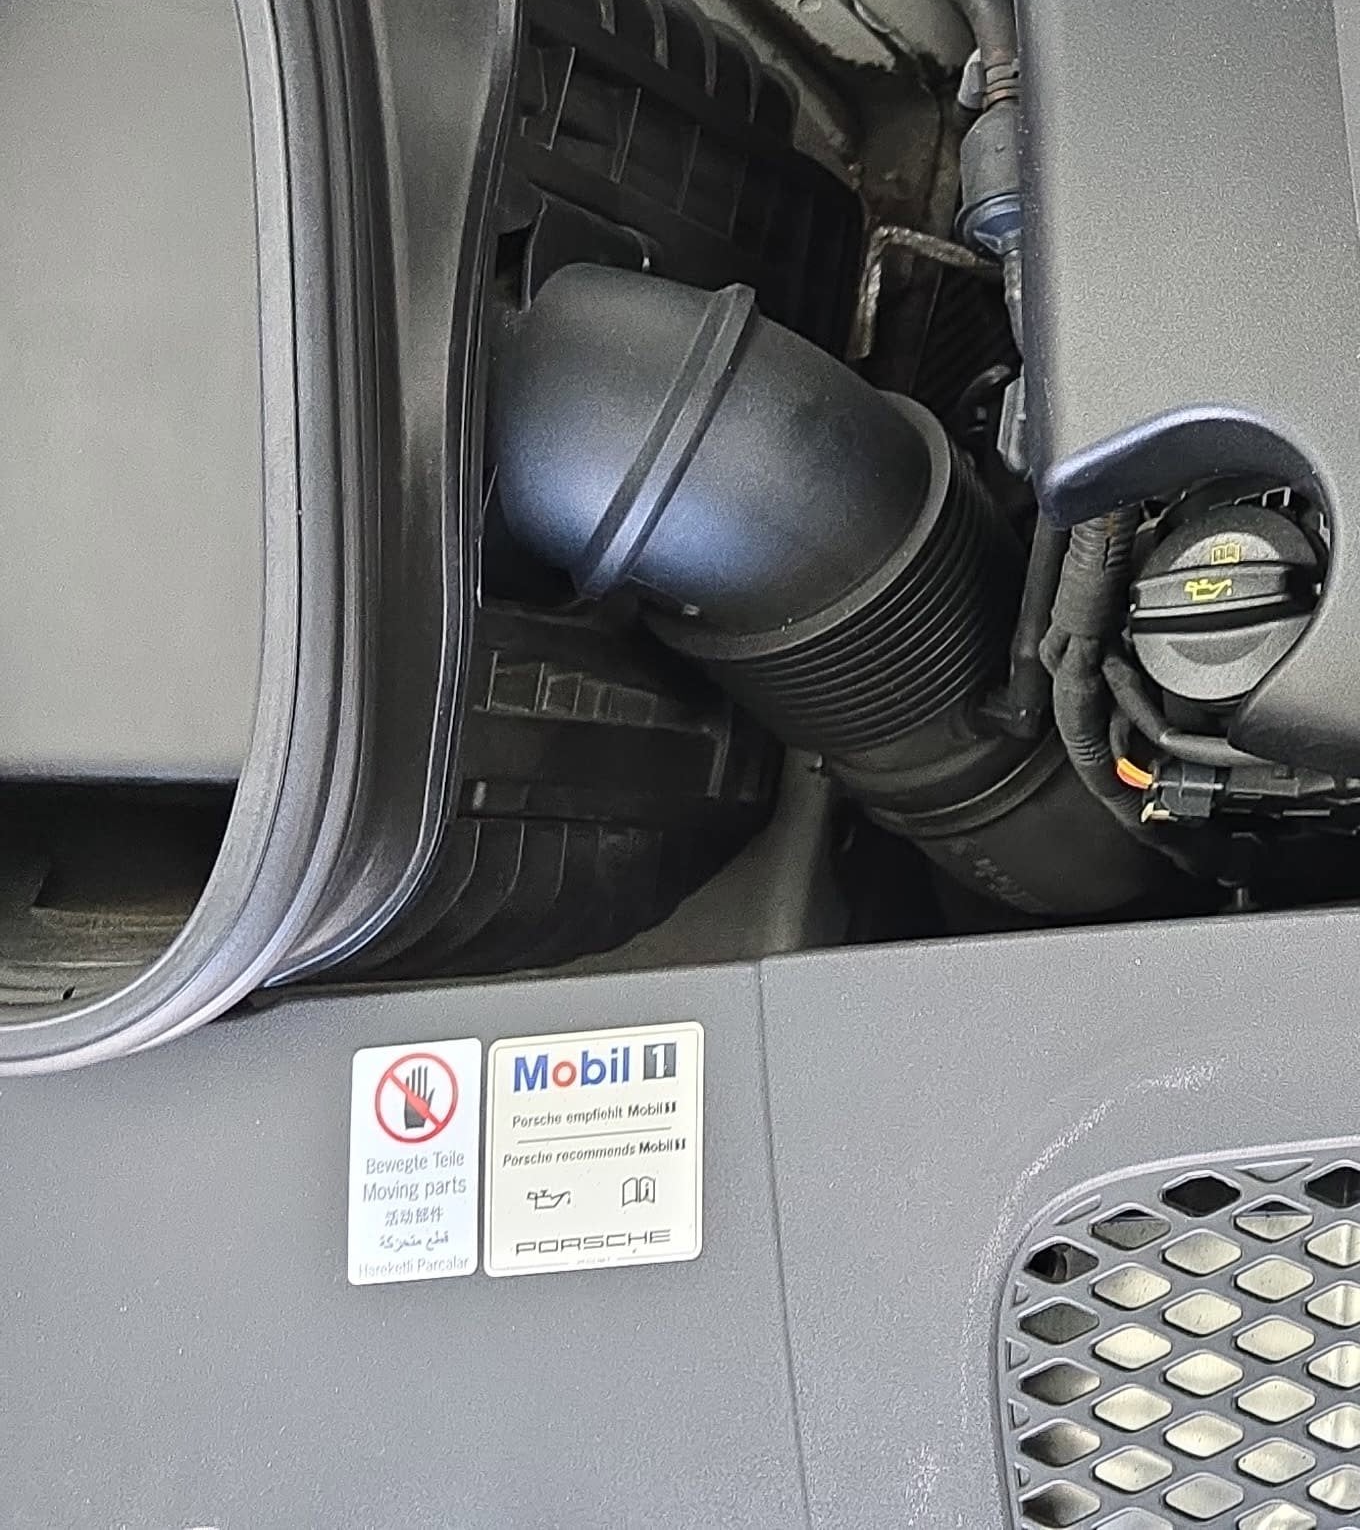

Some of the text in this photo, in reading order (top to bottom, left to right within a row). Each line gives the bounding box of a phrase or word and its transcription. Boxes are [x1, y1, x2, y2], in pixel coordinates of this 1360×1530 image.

[513, 1045, 631, 1092] Mobil
[512, 1111, 562, 1128] Porsche
[566, 1105, 623, 1126] empfiehlt
[366, 1149, 465, 1175] Bewegte Teile
[502, 1149, 553, 1167] Porsche
[555, 1141, 636, 1164] recommends
[363, 1176, 467, 1202] Moving parts
[515, 1229, 672, 1256] PORSCHE
